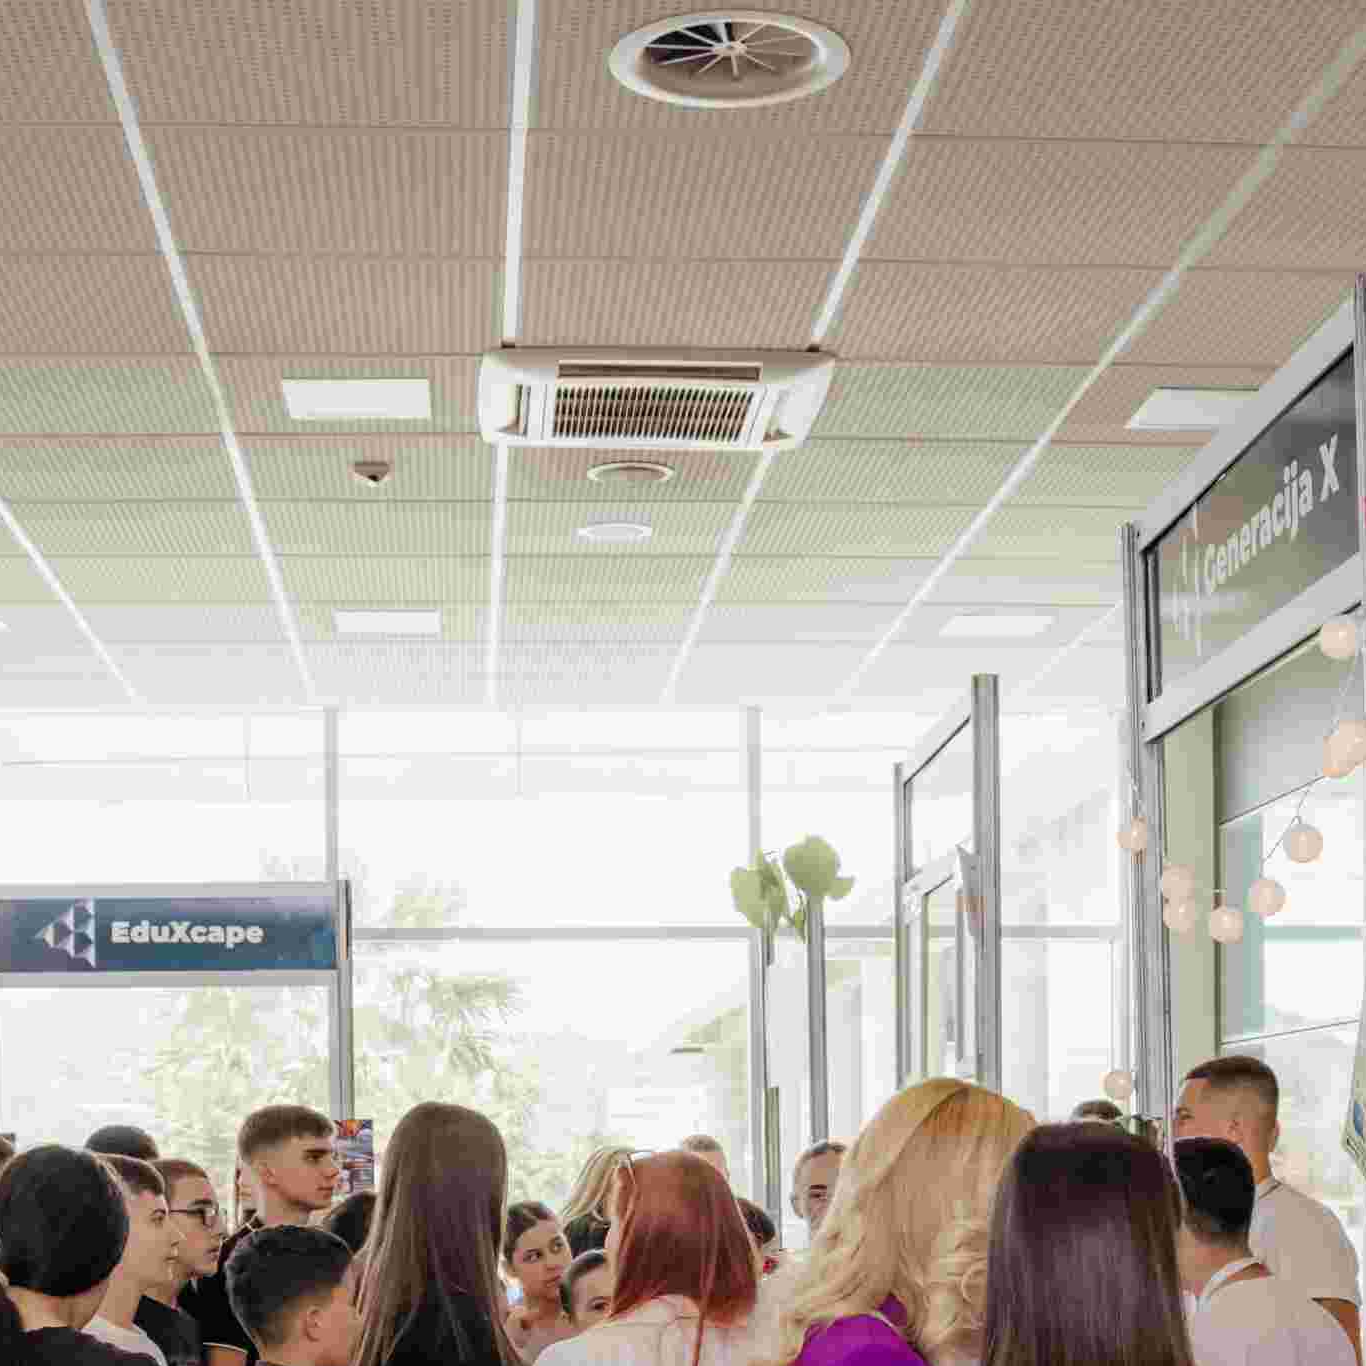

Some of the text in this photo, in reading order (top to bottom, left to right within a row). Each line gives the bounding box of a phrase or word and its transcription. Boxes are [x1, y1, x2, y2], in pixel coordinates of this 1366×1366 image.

[1203, 432, 1340, 595] Generacija X
[109, 920, 265, 949] EduXcape
